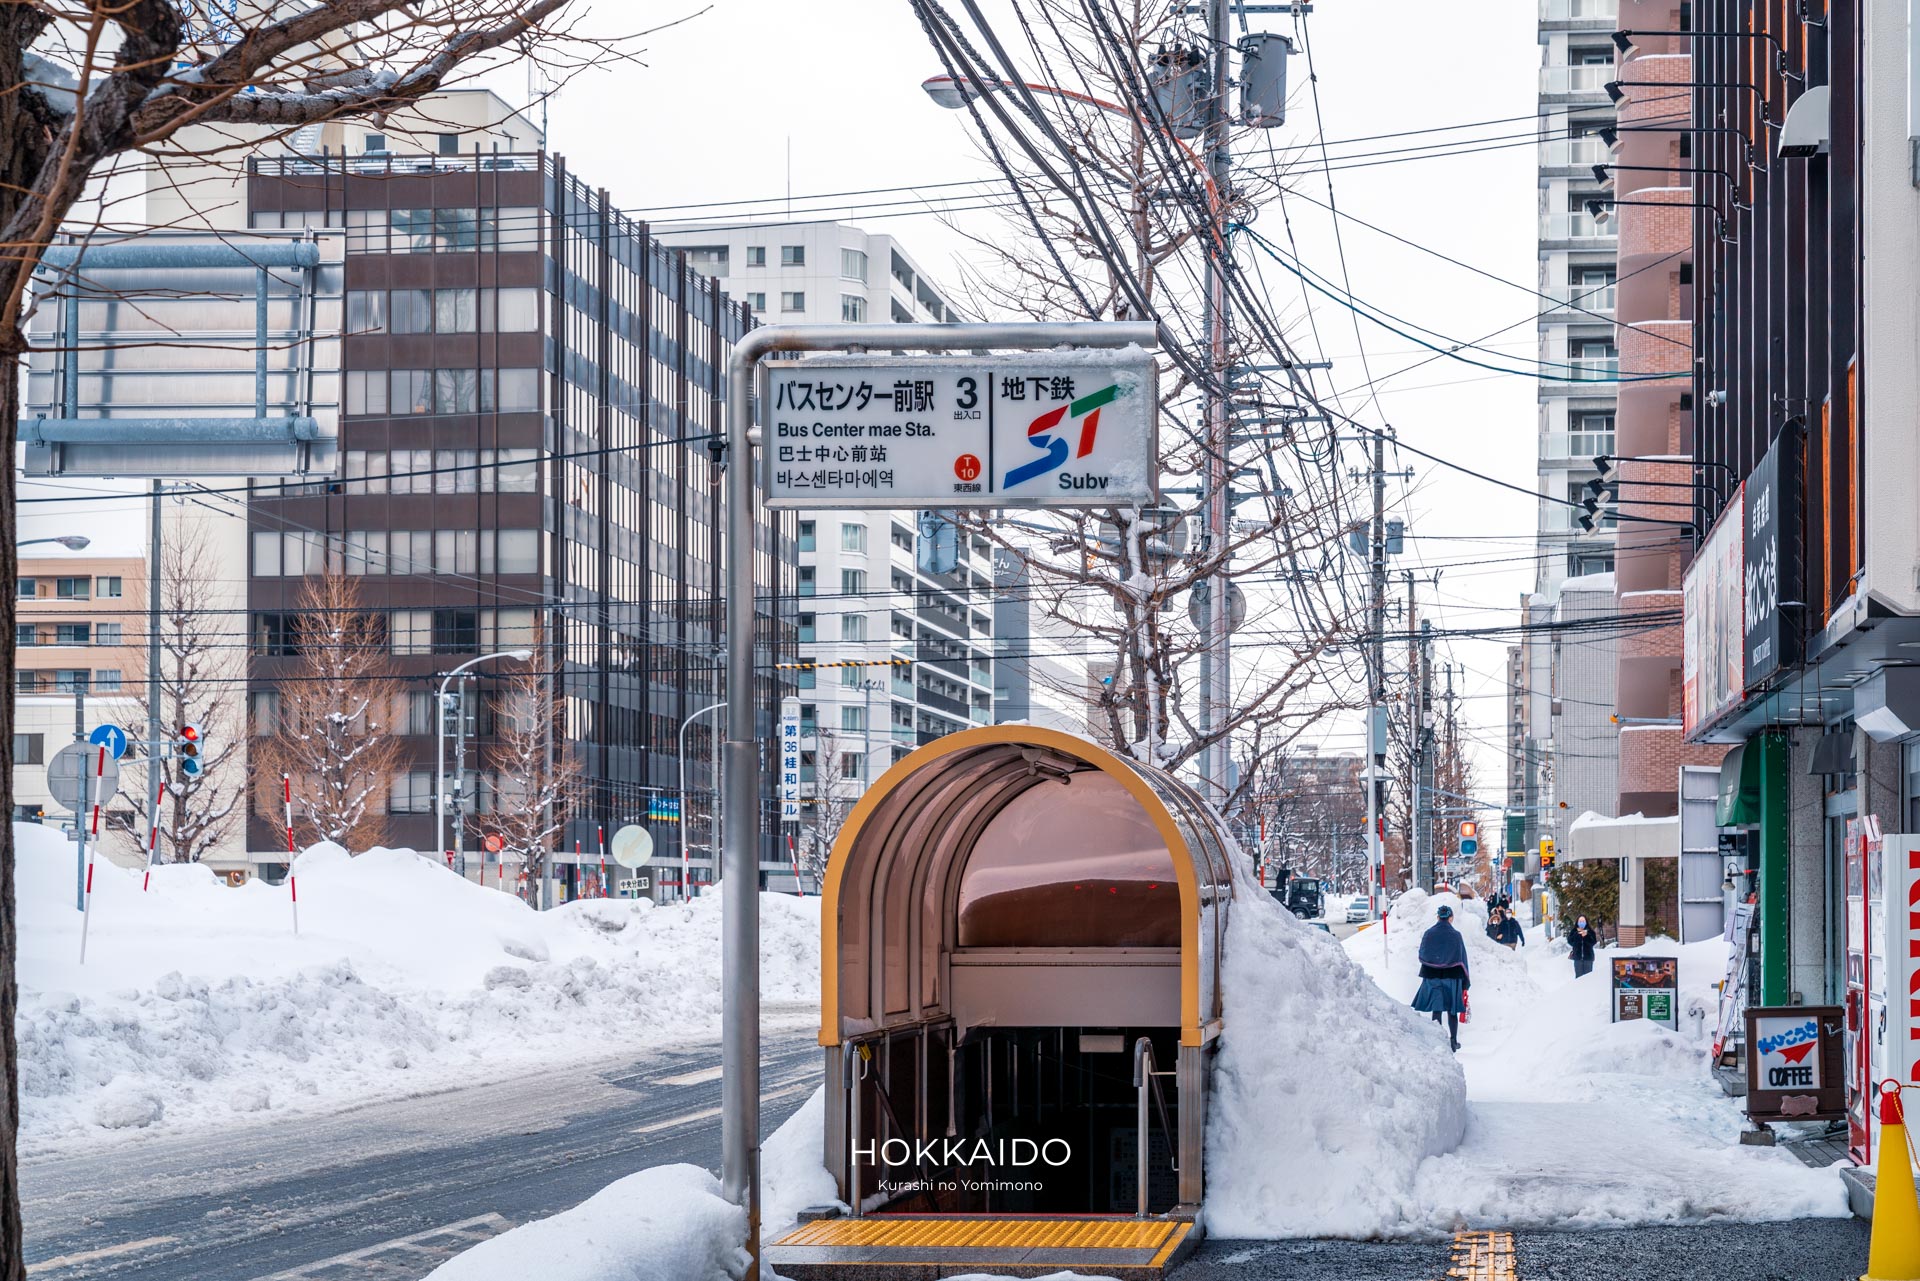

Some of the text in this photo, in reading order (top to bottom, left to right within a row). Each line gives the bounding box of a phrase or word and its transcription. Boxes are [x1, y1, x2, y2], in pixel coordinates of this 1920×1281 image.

[776, 379, 935, 413] バスセンター前駅
[955, 376, 978, 410] 3
[1001, 375, 1075, 401] 地下鉄
[953, 410, 981, 420] 出入口
[777, 421, 936, 437] Bus Center mae Sta.
[779, 444, 888, 463] 巴士中心前站
[963, 456, 972, 467] T
[777, 469, 894, 489] 바스센타마에역
[961, 468, 975, 479] 10
[1059, 472, 1110, 490] Subw
[953, 483, 981, 493] 東西線
[1541, 857, 1551, 867] P
[1768, 1065, 1813, 1087] COFFEE
